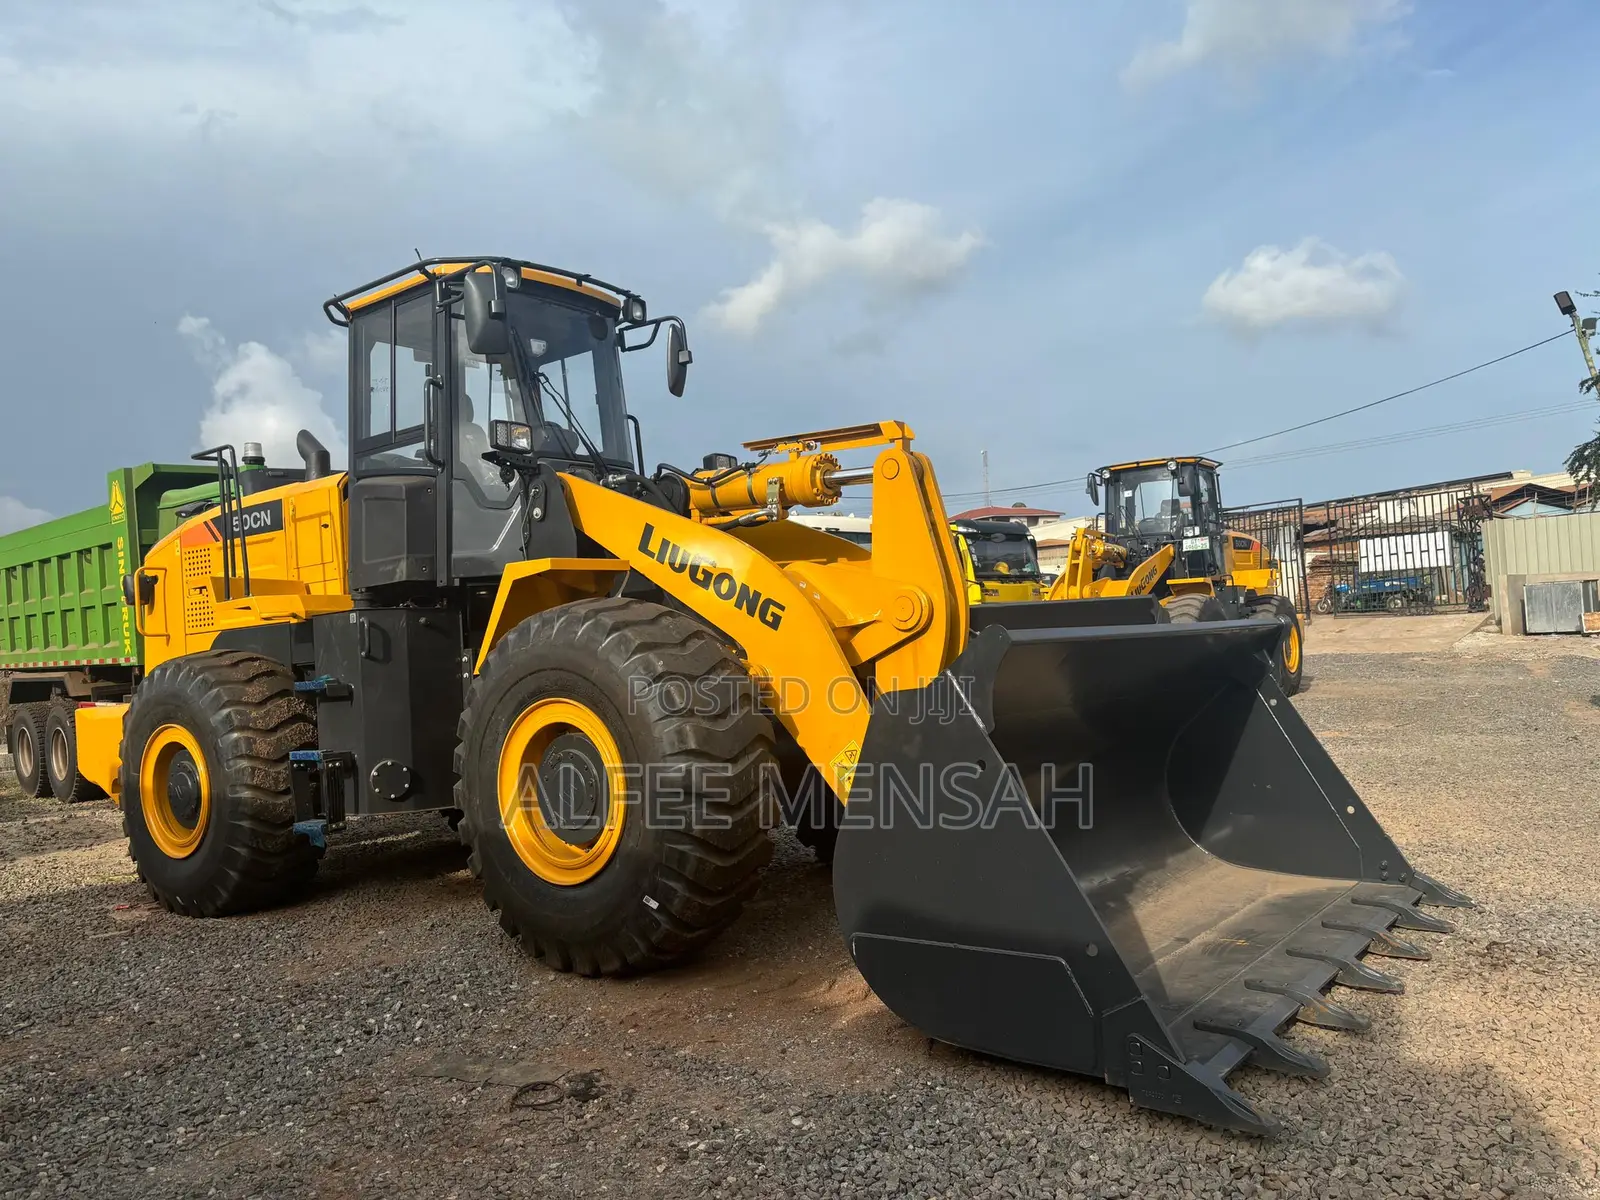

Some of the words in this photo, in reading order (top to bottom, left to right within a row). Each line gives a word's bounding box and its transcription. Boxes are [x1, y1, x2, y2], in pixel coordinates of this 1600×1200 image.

[233, 509, 271, 531] 50CN
[117, 536, 131, 655] SINRUK
[637, 522, 786, 631] LIUGONG
[1130, 565, 1158, 596] IUGONG
